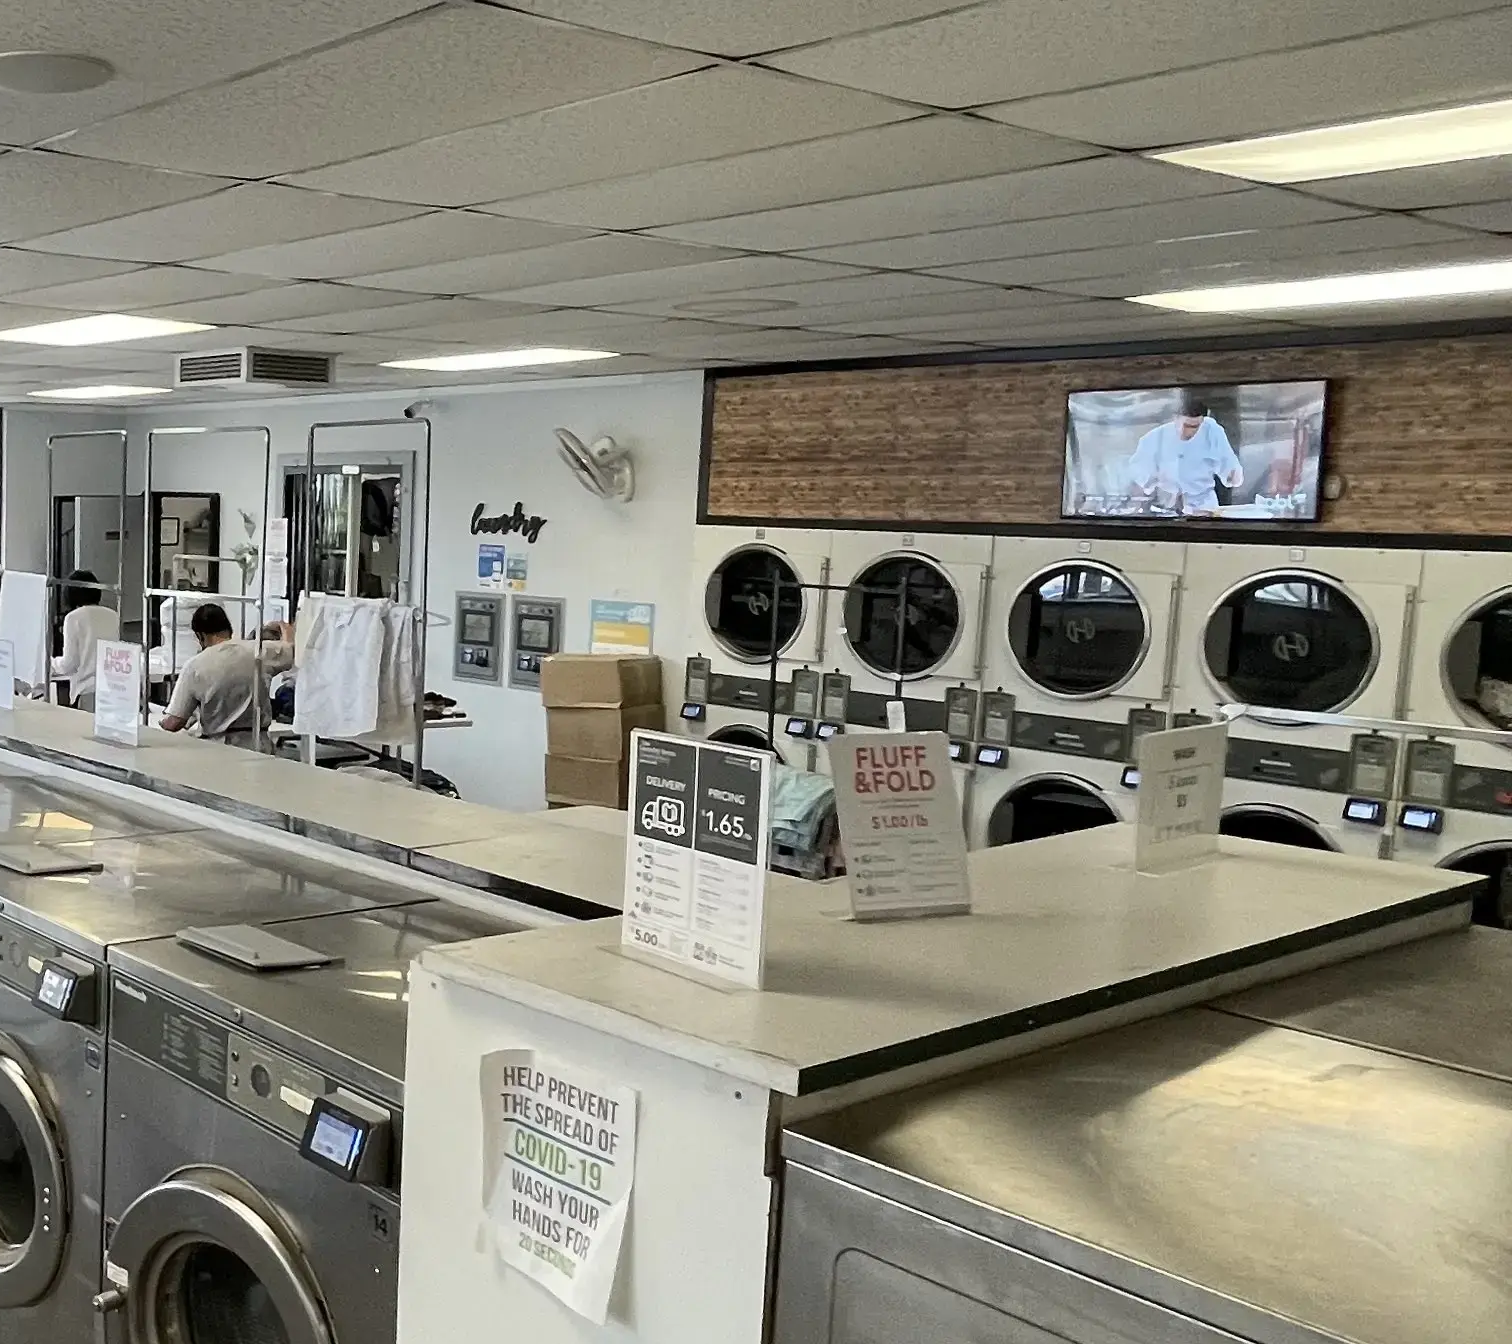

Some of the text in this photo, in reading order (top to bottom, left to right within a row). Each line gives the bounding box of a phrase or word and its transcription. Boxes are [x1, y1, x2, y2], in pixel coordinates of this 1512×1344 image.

[855, 746, 927, 769] FLUFF
[646, 775, 686, 792] DELIVERY
[854, 769, 936, 794] &FOLD
[708, 788, 746, 805] PRICING
[503, 1066, 619, 1124] HELP PREVENT
[500, 1093, 620, 1155] THE SPREAD OF
[514, 1128, 603, 1192] COVID-19
[512, 1167, 600, 1231] WASH YOUR
[374, 1213, 388, 1237] 14
[512, 1199, 591, 1261] HANDS FOR
[518, 1231, 533, 1253] 20
